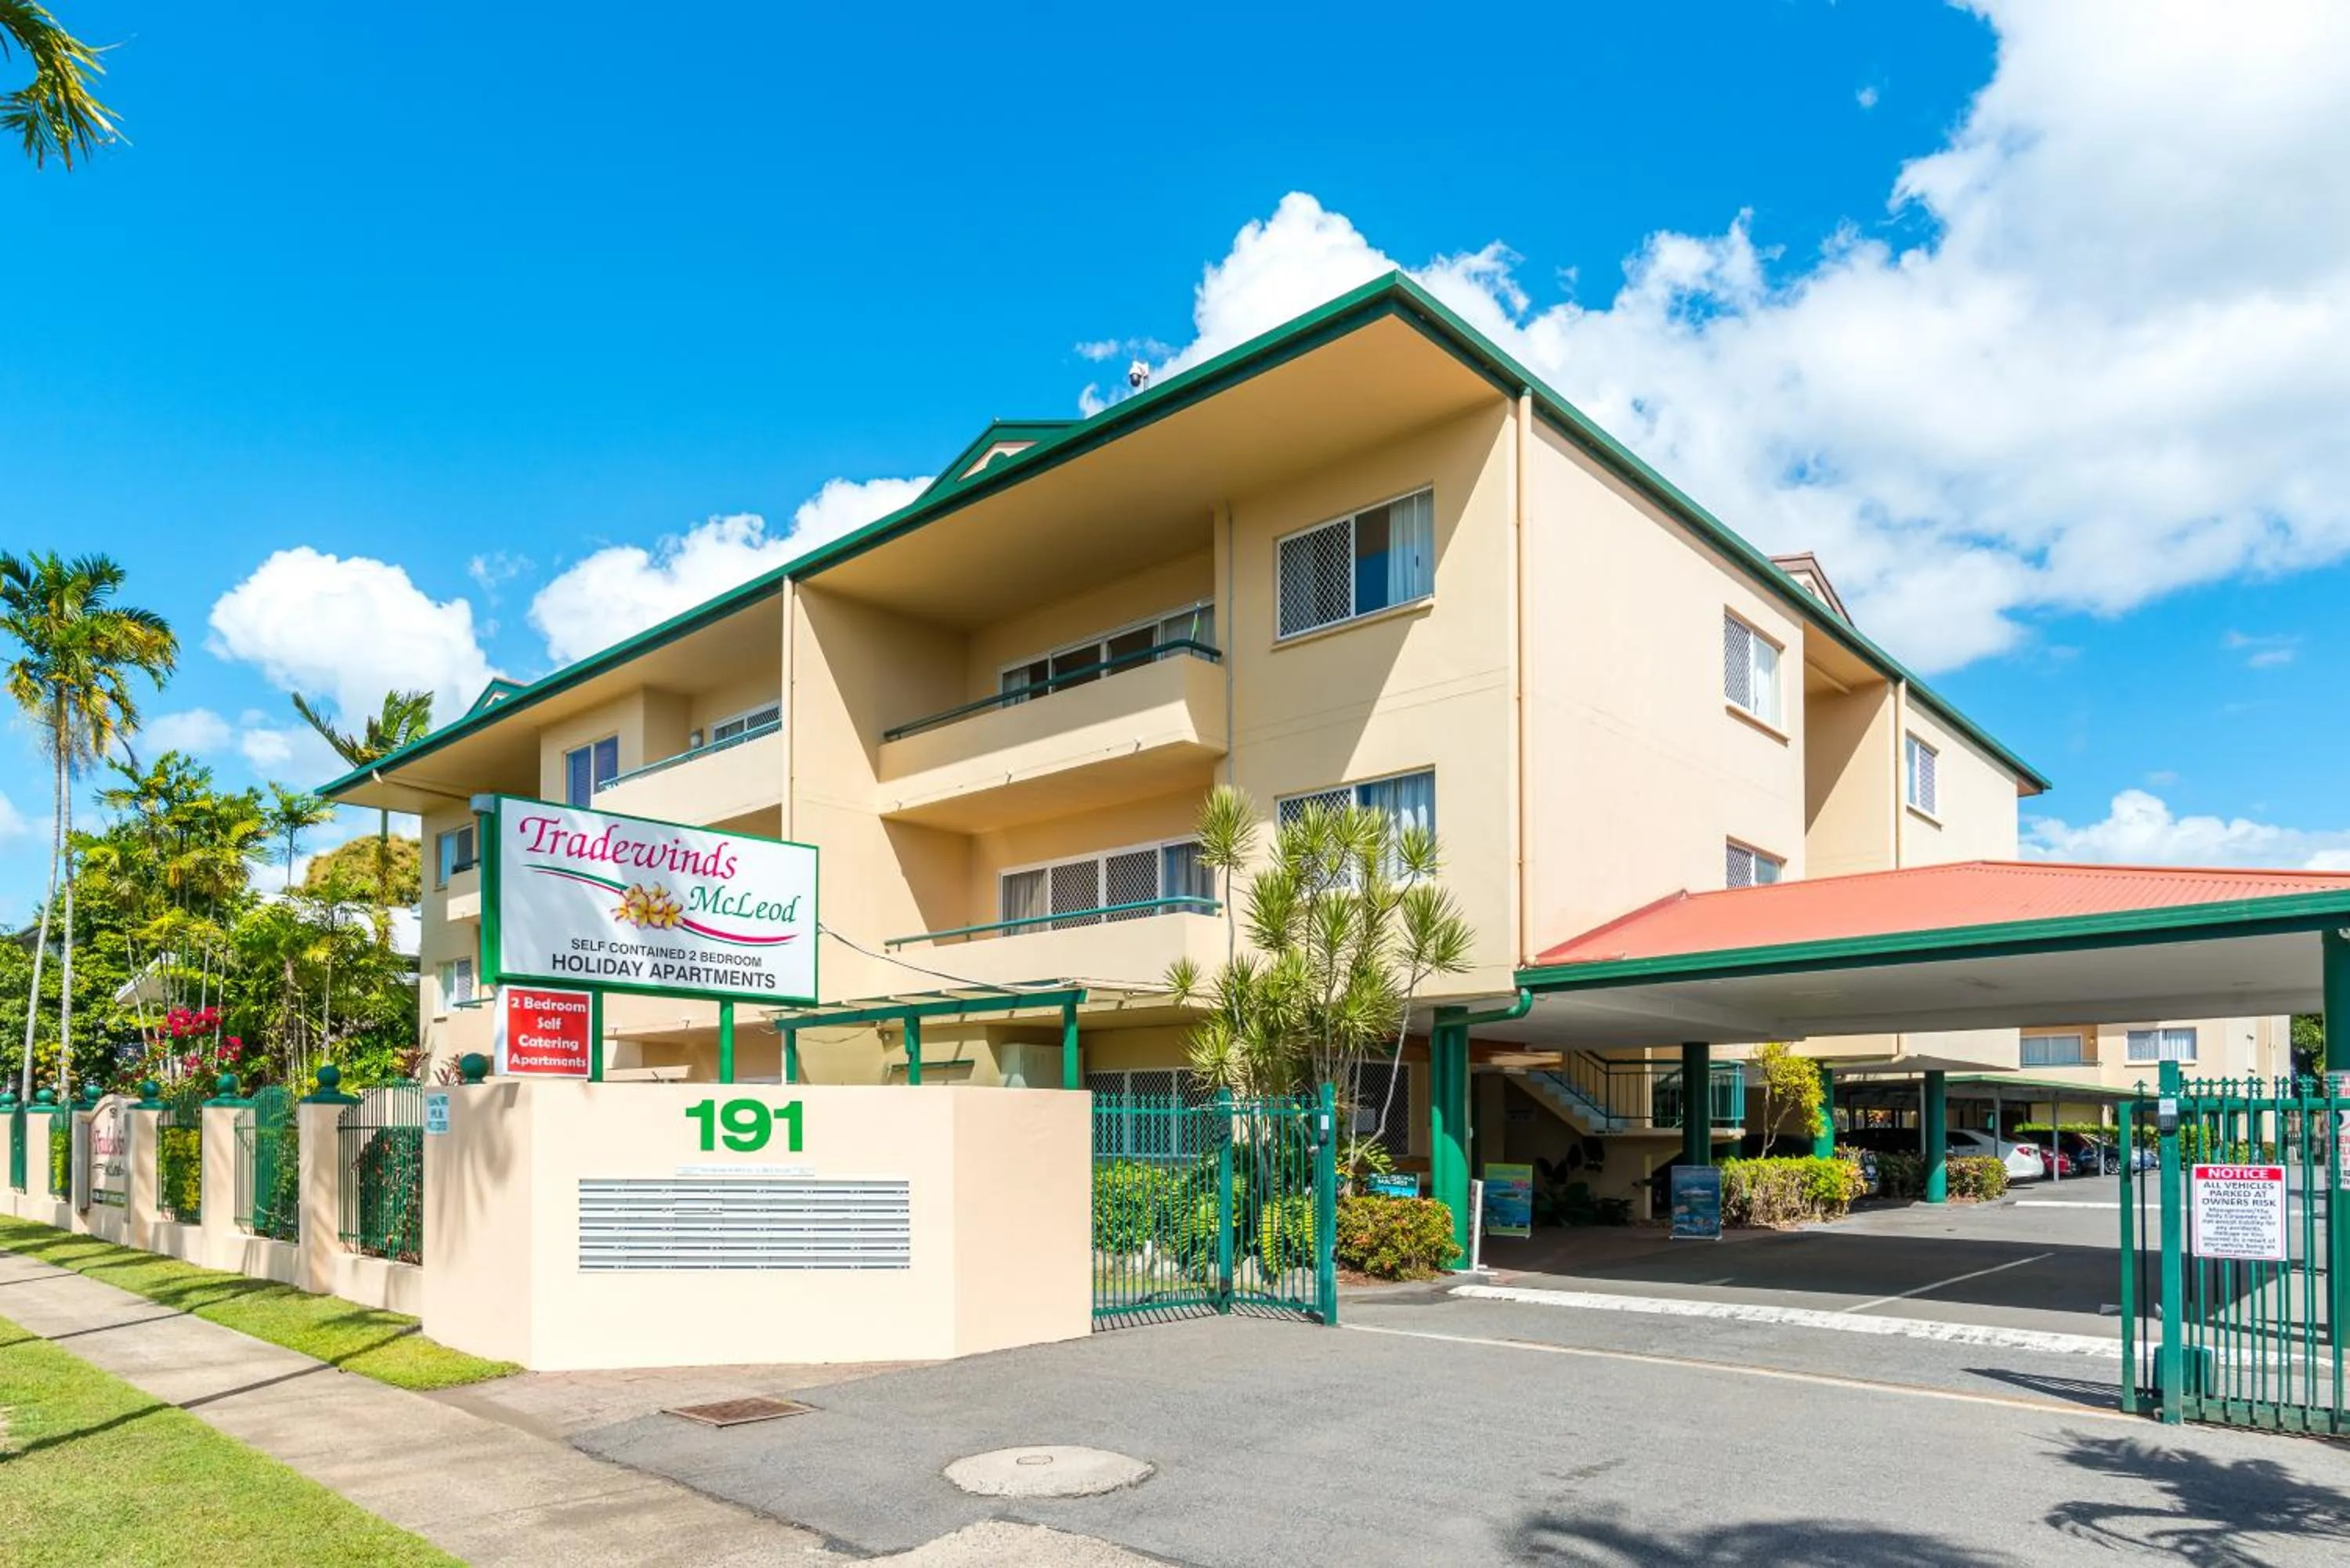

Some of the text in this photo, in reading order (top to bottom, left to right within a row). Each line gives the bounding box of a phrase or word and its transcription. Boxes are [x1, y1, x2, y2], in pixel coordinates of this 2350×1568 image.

[519, 816, 737, 880] Tradewinds
[688, 885, 801, 923] McLeod
[571, 938, 762, 967] SELF CONTAINED 2 BEDROOM
[551, 953, 777, 990] HOLIDAY APARTMENTS
[511, 996, 587, 1013] 2 Bedroom
[537, 1017, 562, 1030] Self
[518, 1034, 580, 1052] Catering
[510, 1053, 588, 1068] Apartments
[685, 1098, 804, 1153] 191
[2208, 1167, 2269, 1179] NOTICE
[2202, 1198, 2249, 1206] OWNERS
